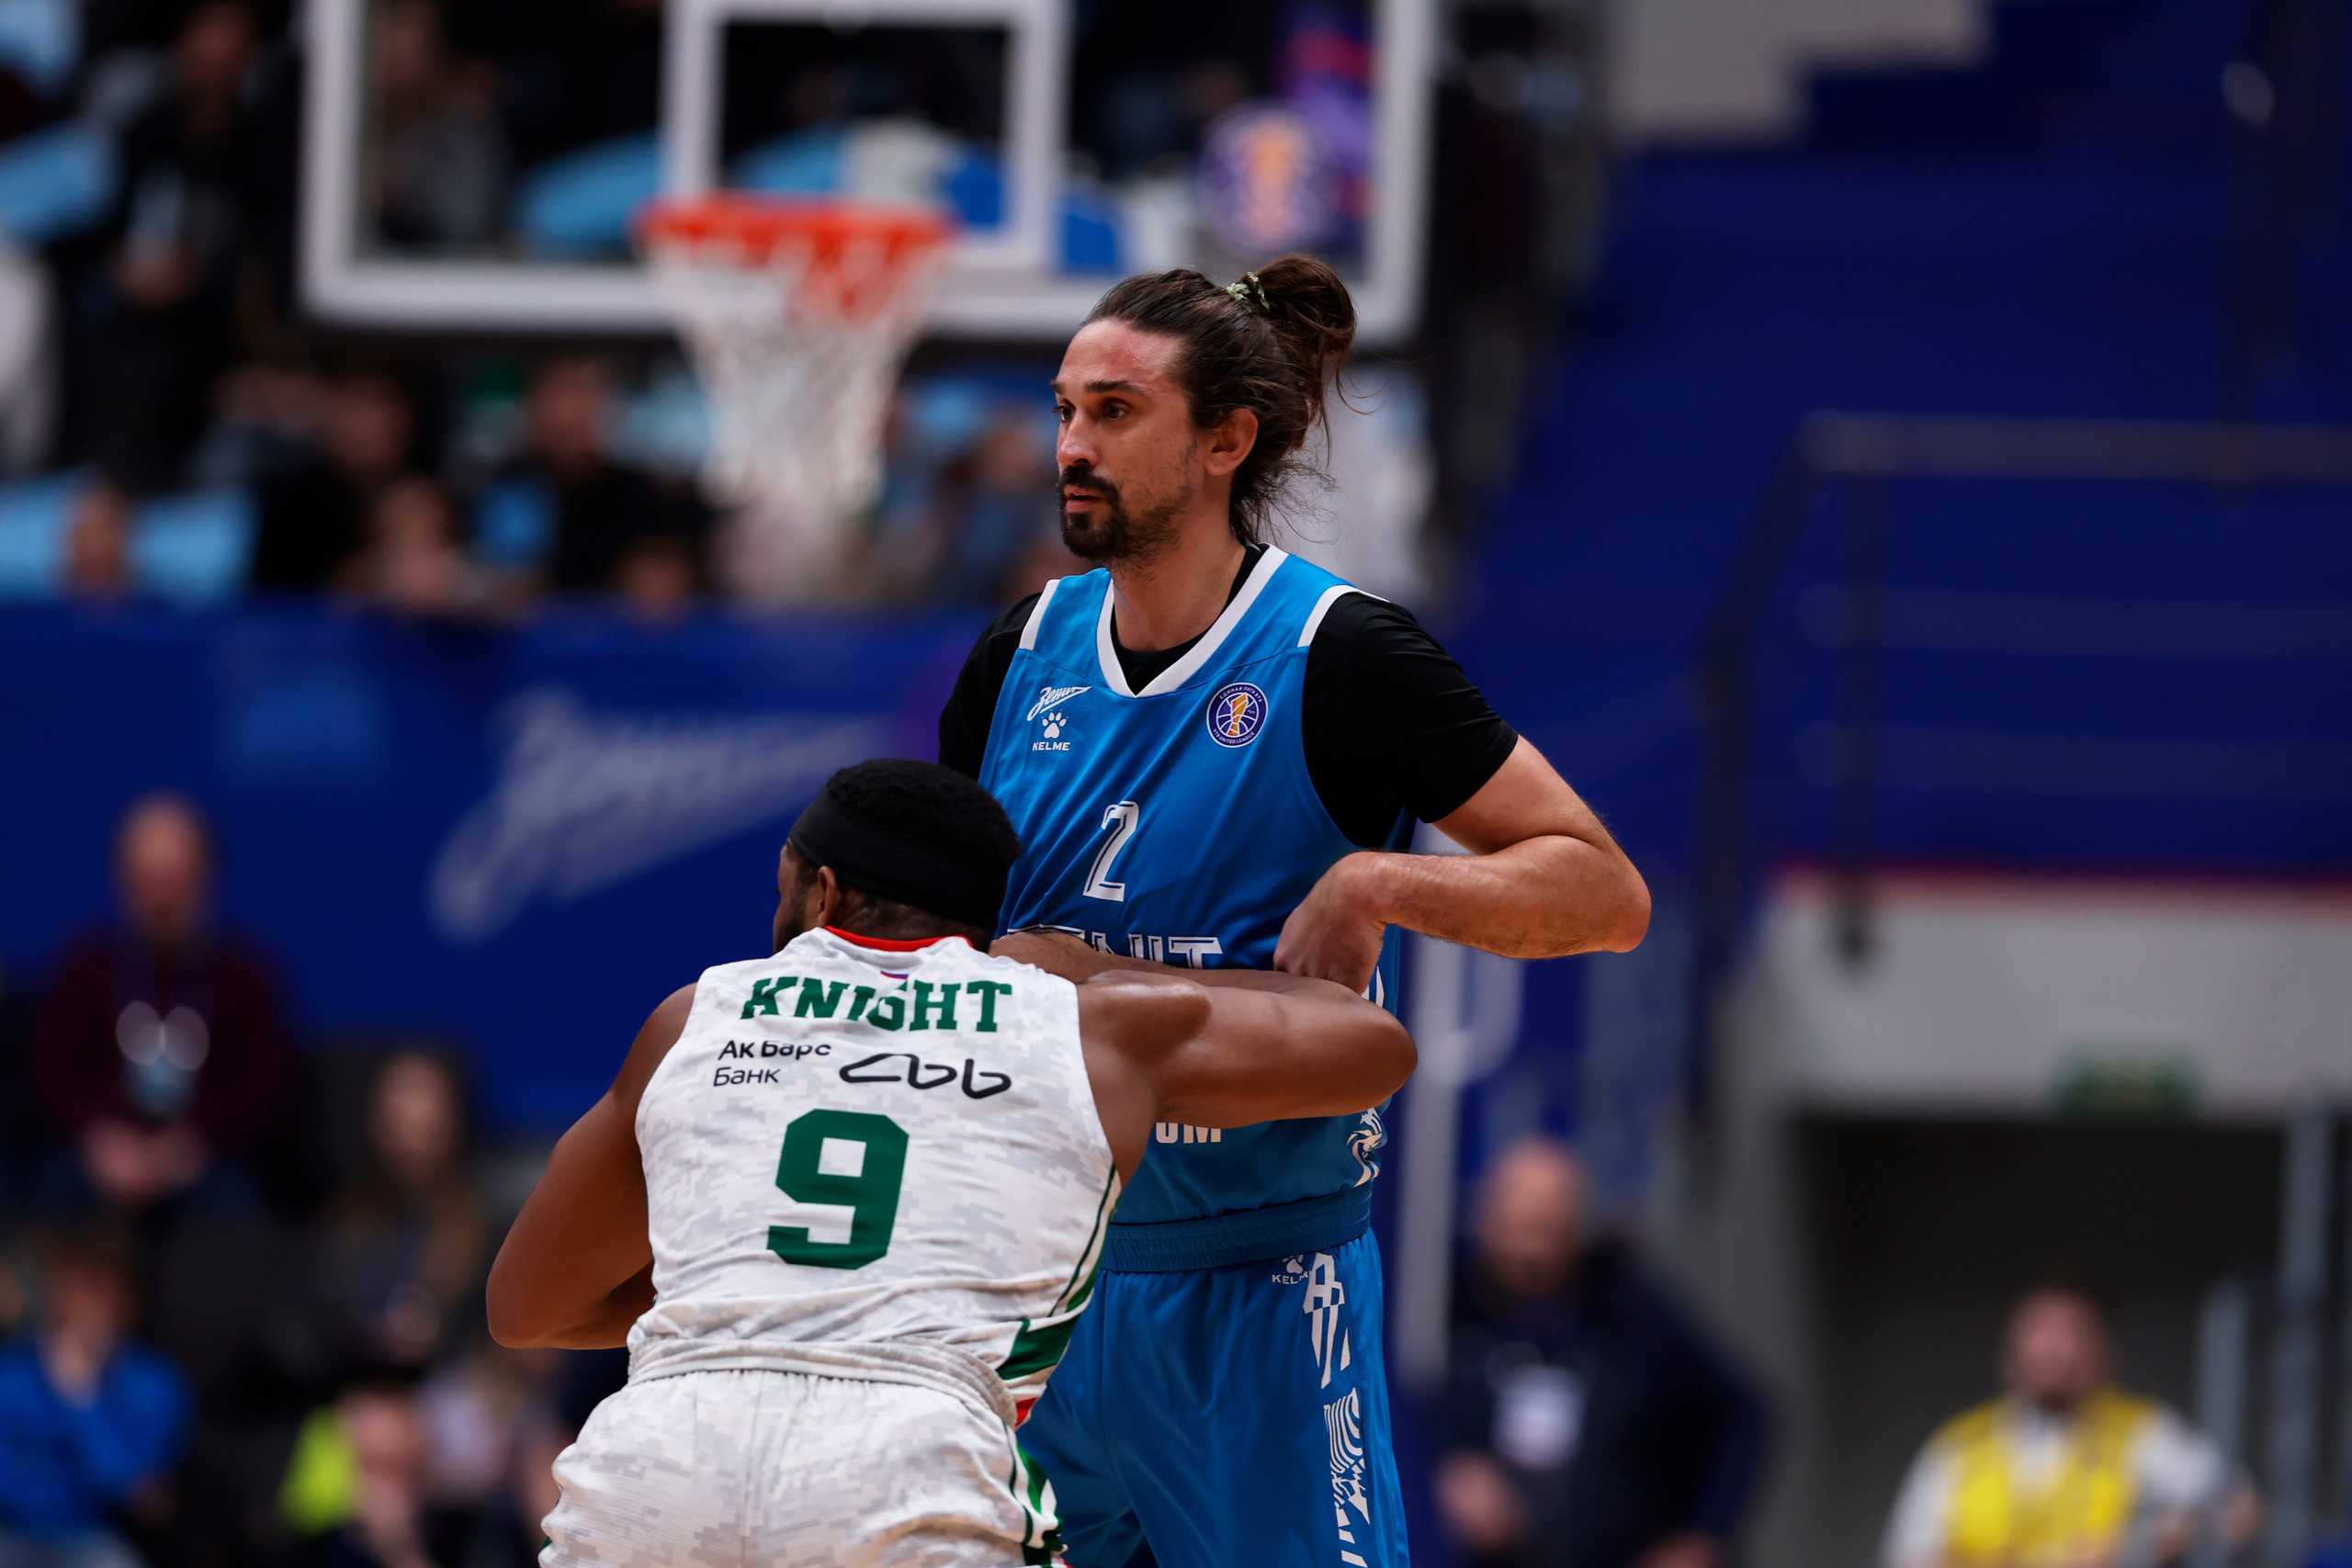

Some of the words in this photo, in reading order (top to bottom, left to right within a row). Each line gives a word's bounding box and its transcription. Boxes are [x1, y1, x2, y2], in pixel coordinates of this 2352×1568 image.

[1032, 741, 1070, 751] KELME
[1236, 731, 1255, 744] LEAGUE
[1082, 800, 1140, 903] 2
[740, 975, 1012, 1032] KNIGHT
[718, 1039, 755, 1060] Ак
[761, 1040, 831, 1060] Барс
[713, 1066, 781, 1087] Банк
[766, 1108, 910, 1270] 9
[1272, 1270, 1313, 1285] KELM
